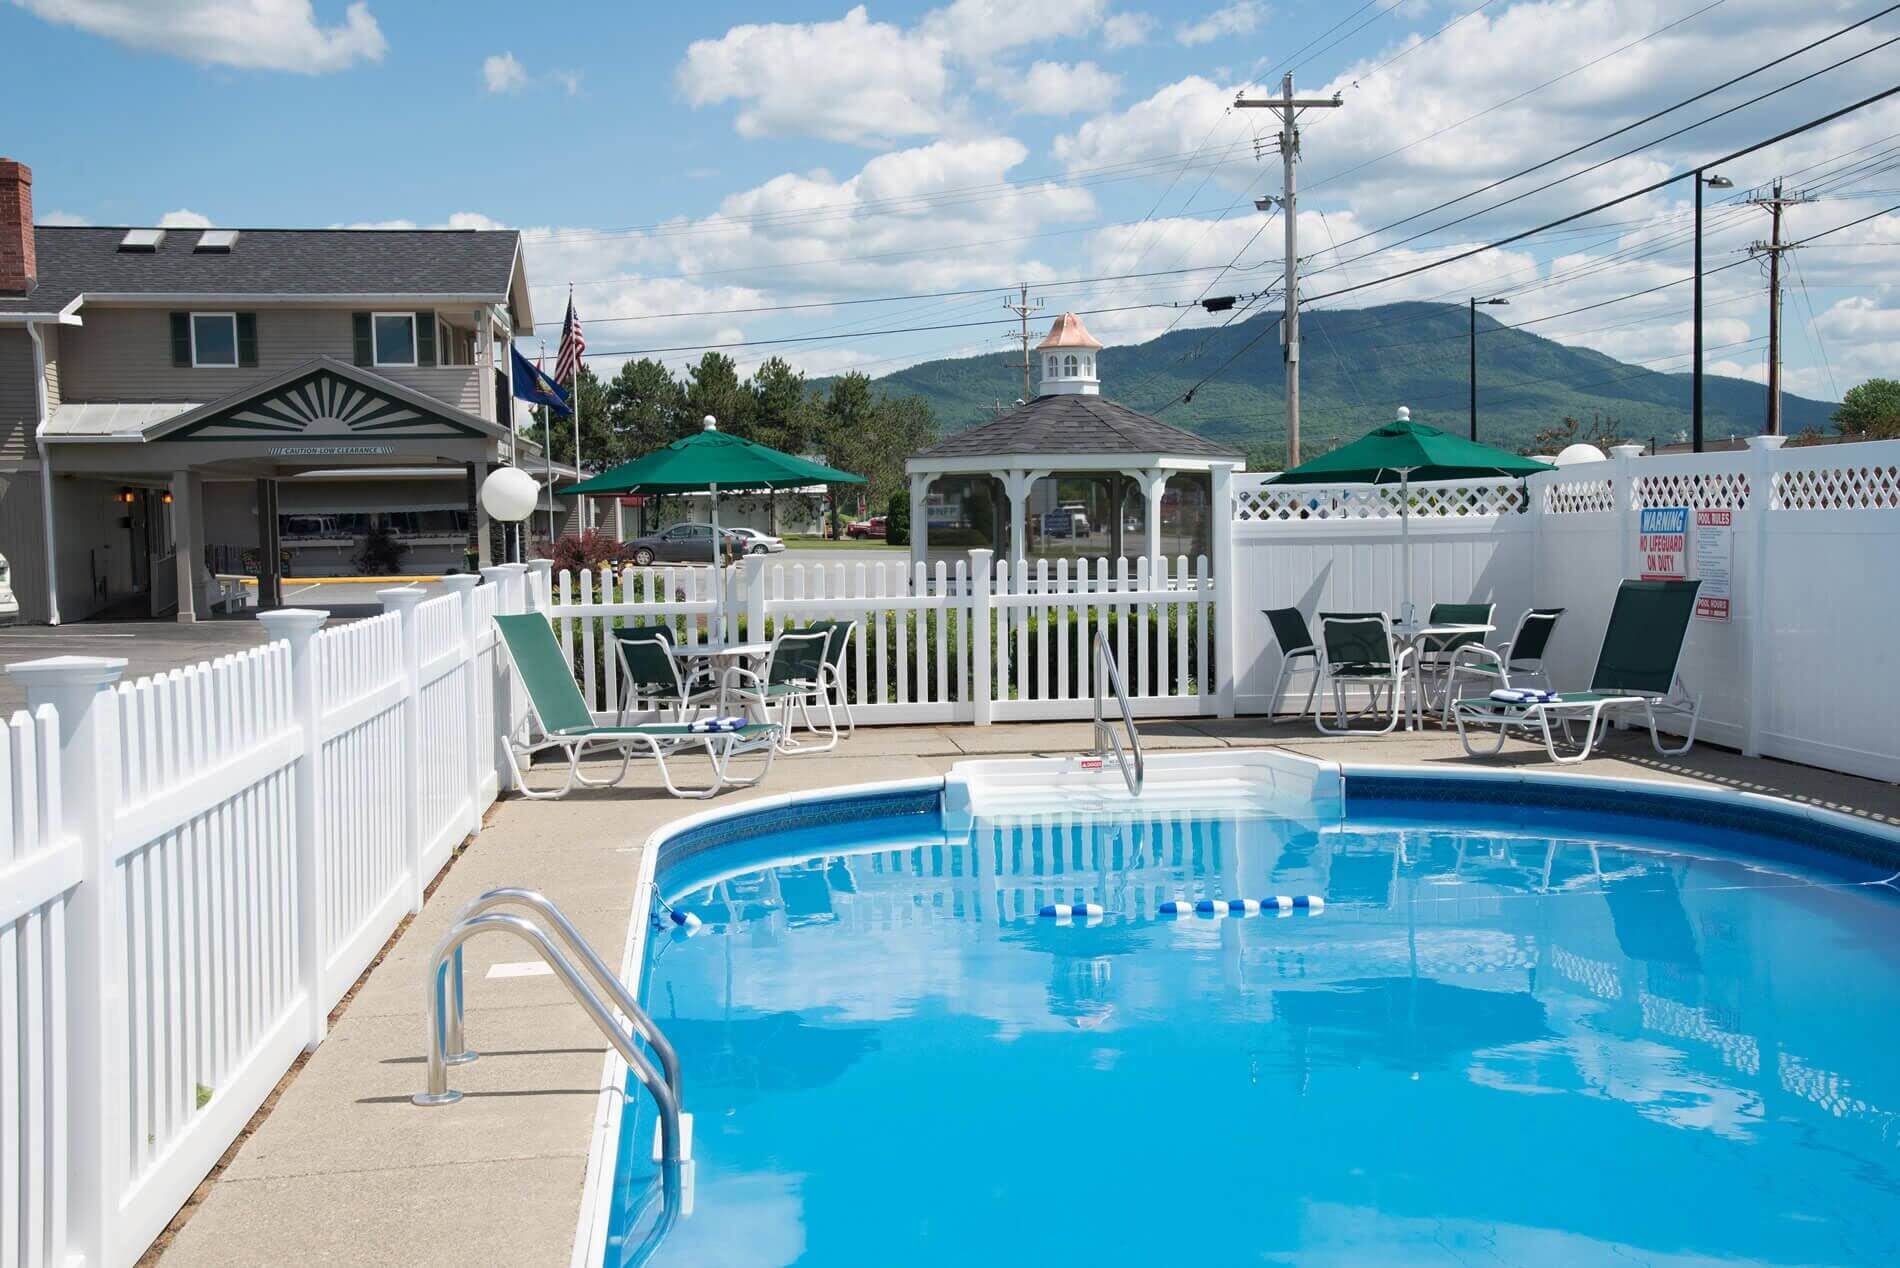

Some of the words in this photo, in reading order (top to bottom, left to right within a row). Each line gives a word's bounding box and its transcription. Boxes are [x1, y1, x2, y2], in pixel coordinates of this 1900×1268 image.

[1643, 511, 1684, 531] WARNING
[1697, 512, 1711, 525] POOL
[1711, 512, 1730, 526] RULES
[1640, 535, 1648, 552] NO
[1649, 535, 1683, 552] LIFEGUARD
[1647, 555, 1657, 572] ON
[1658, 555, 1674, 572] DUTY
[1698, 599, 1710, 608] POOL
[1711, 600, 1727, 609] HOURS
